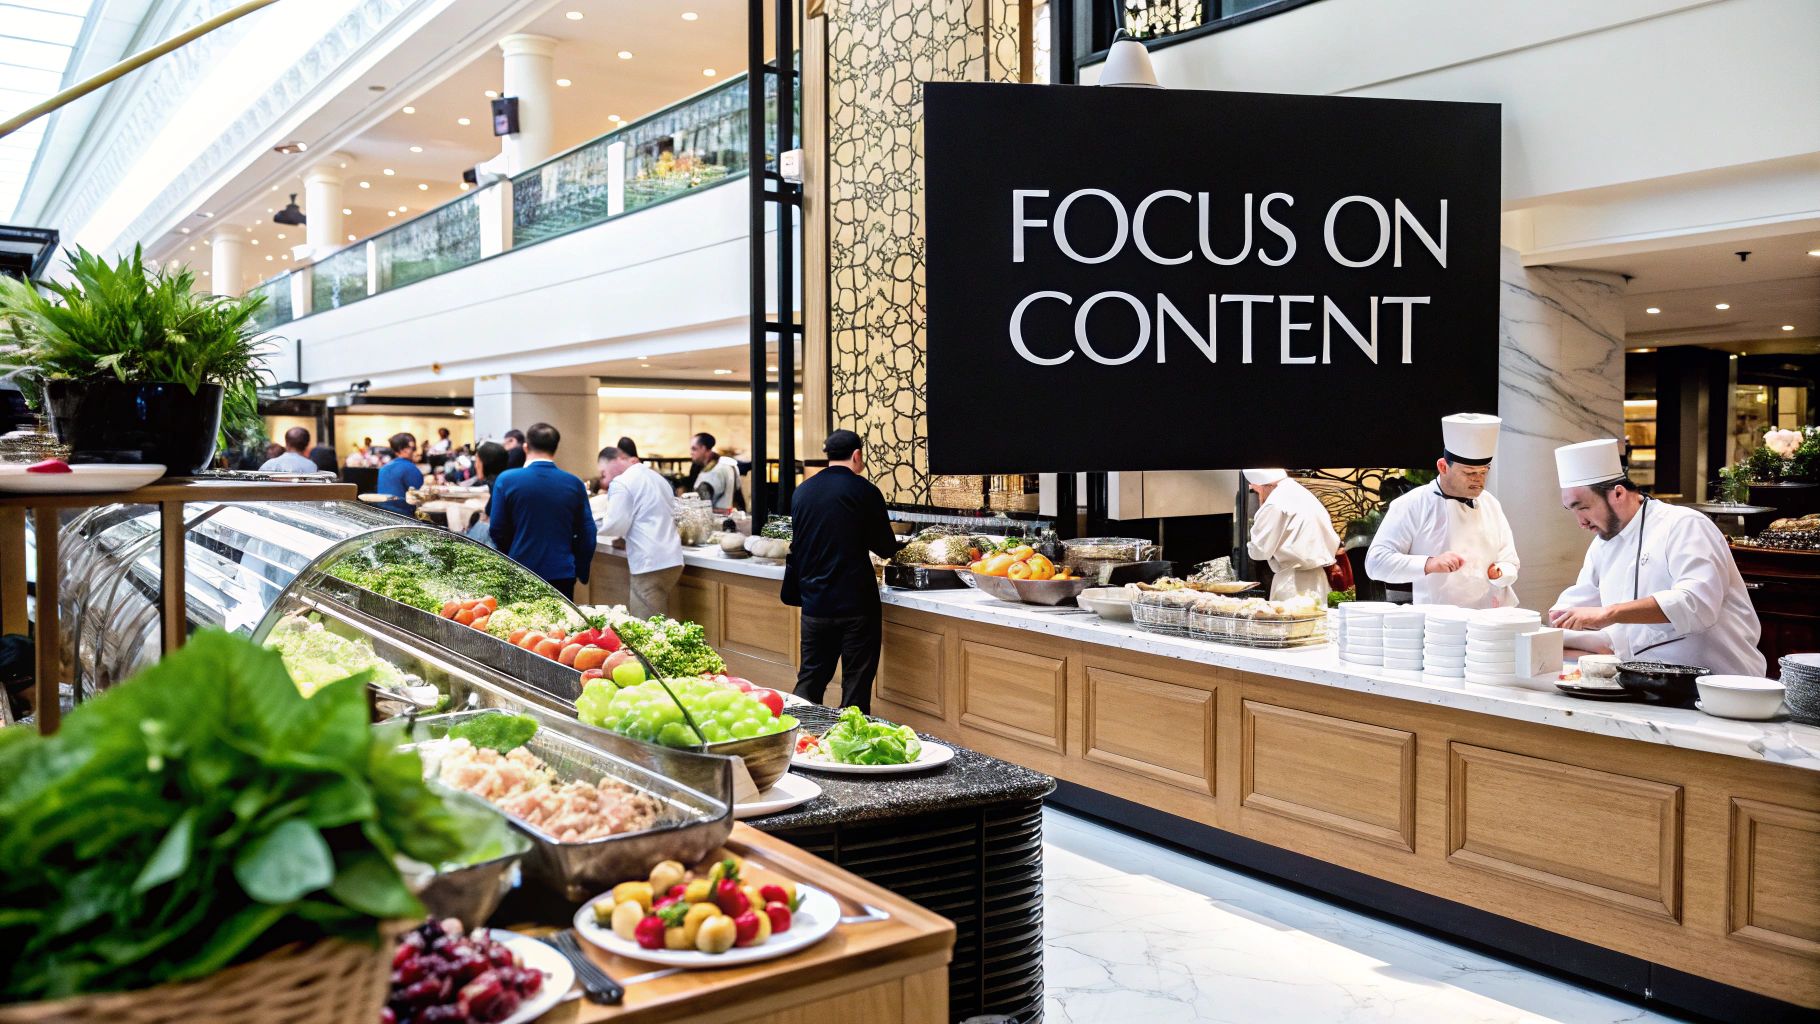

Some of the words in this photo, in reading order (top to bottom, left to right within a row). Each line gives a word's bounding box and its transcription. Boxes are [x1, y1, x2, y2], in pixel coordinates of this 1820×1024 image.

[1012, 188, 1297, 267] FOCUS
[1323, 195, 1448, 269] ON
[1009, 290, 1431, 366] CONTENT
